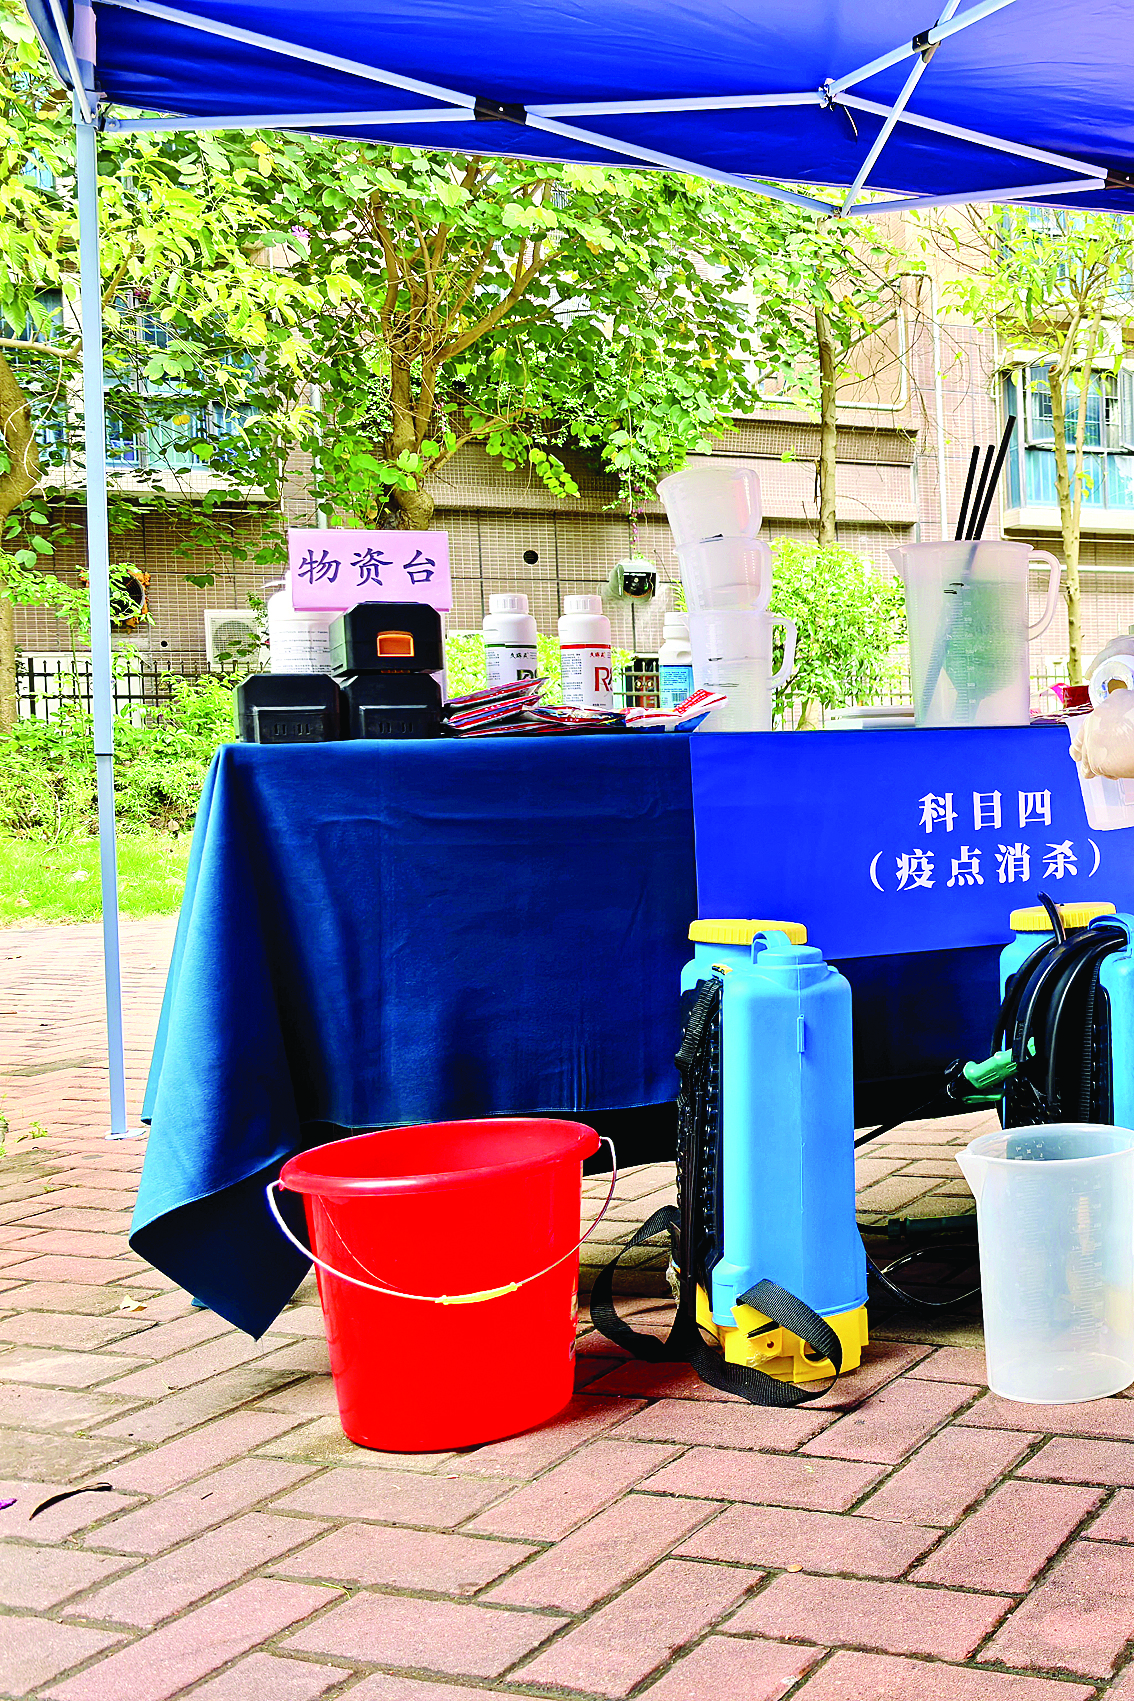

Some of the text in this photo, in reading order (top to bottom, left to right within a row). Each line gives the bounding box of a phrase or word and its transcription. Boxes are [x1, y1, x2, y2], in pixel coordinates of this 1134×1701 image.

[298, 547, 436, 588] 物资台
[918, 788, 1054, 834] 科目四
